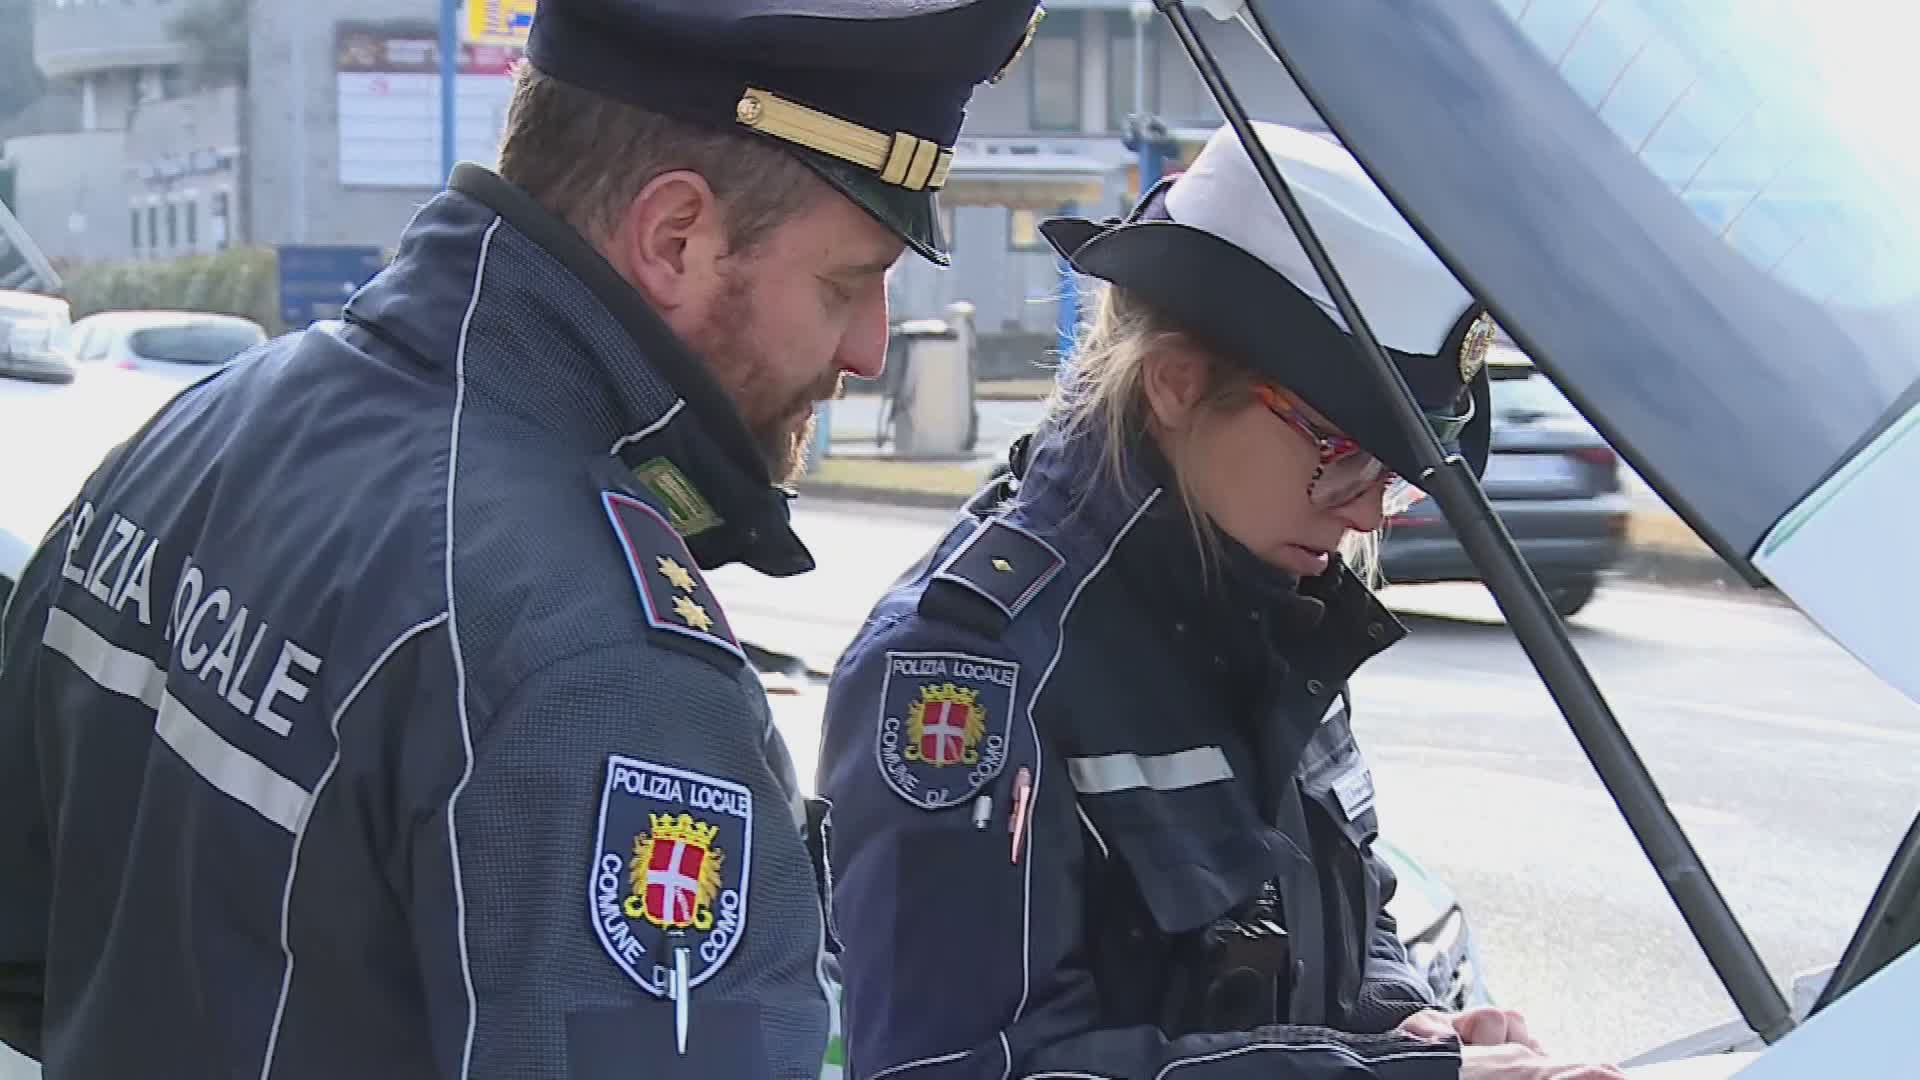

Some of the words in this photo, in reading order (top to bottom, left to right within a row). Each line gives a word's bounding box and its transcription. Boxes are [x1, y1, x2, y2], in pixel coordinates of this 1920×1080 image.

[893, 659, 947, 676] POLIZIA
[953, 661, 1013, 686] LOCALE
[882, 717, 920, 792] COMUNE
[968, 735, 1002, 786] COMO
[612, 767, 683, 803] POLIZIA
[690, 784, 748, 818] LOCALE
[598, 853, 647, 965] COMUNE
[700, 889, 739, 962] COMO
